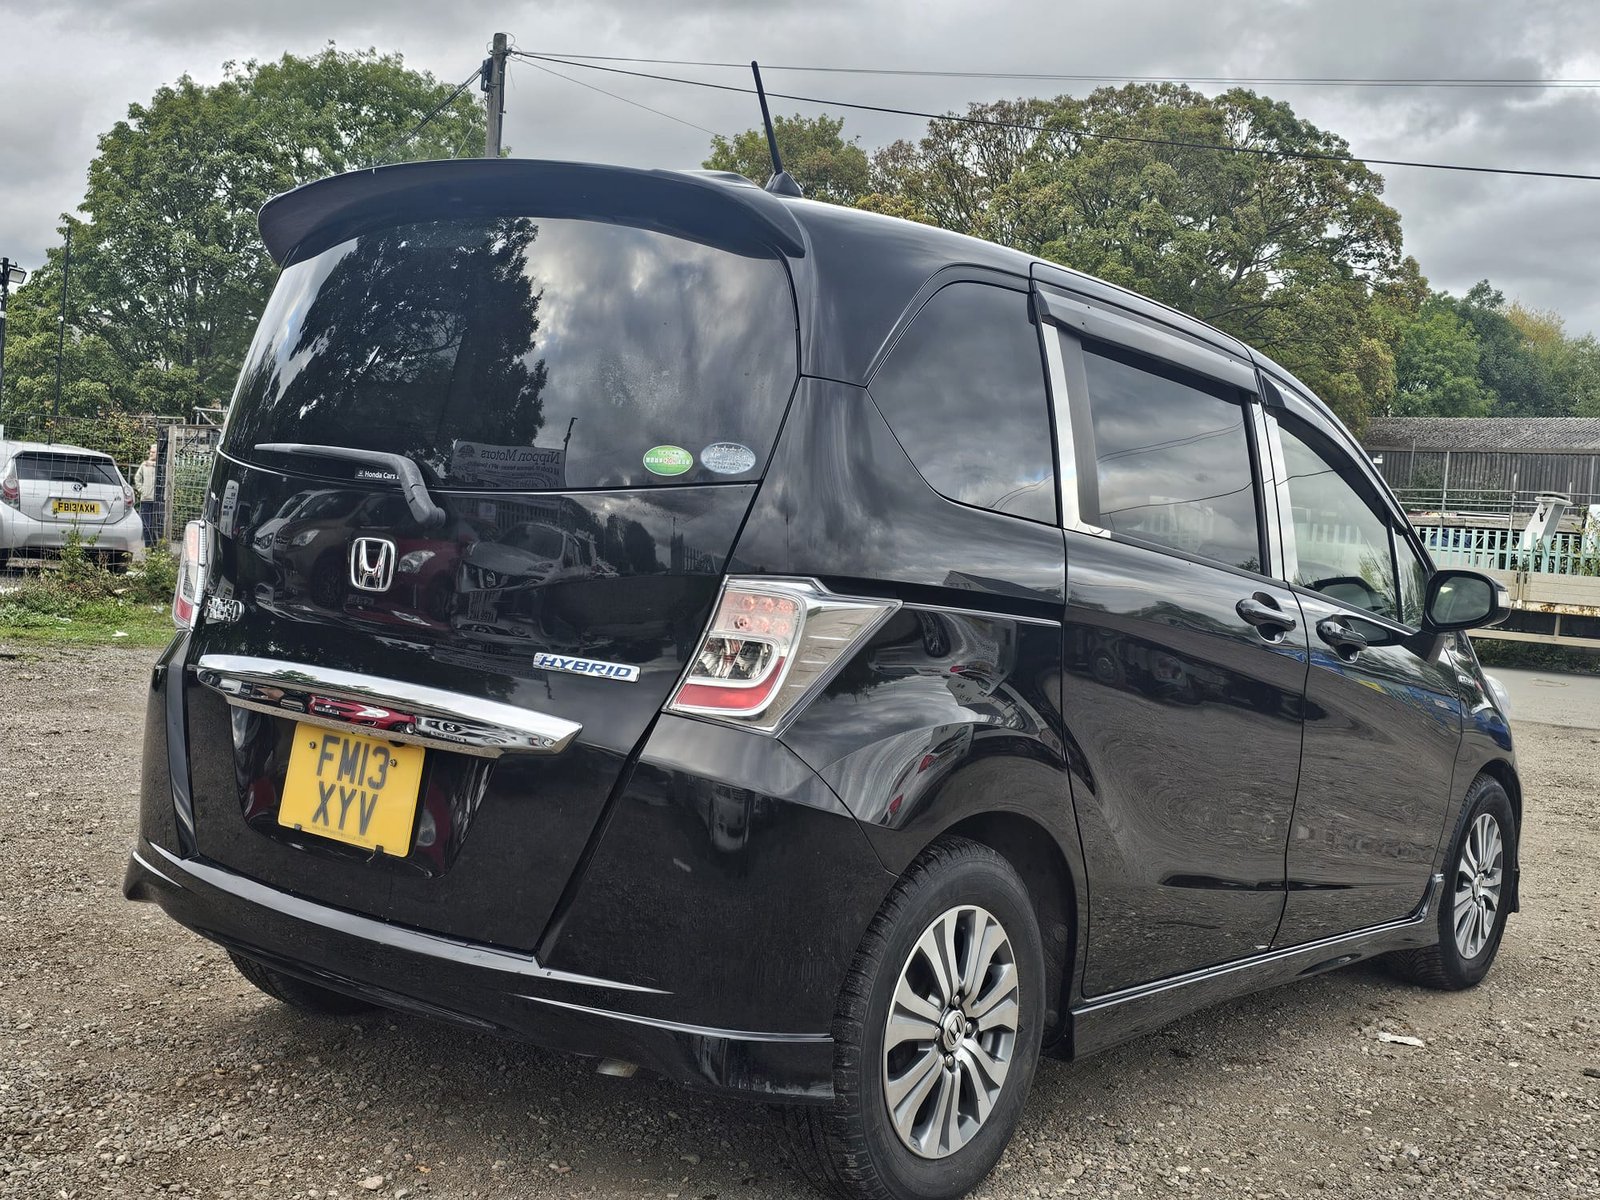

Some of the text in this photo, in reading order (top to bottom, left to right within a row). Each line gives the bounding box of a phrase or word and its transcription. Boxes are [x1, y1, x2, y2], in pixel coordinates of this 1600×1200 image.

[364, 470, 382, 479] Honda
[383, 472, 396, 480] Cars
[539, 656, 632, 678] HYBRID
[316, 733, 391, 791] FM13
[311, 780, 379, 836] XYV
